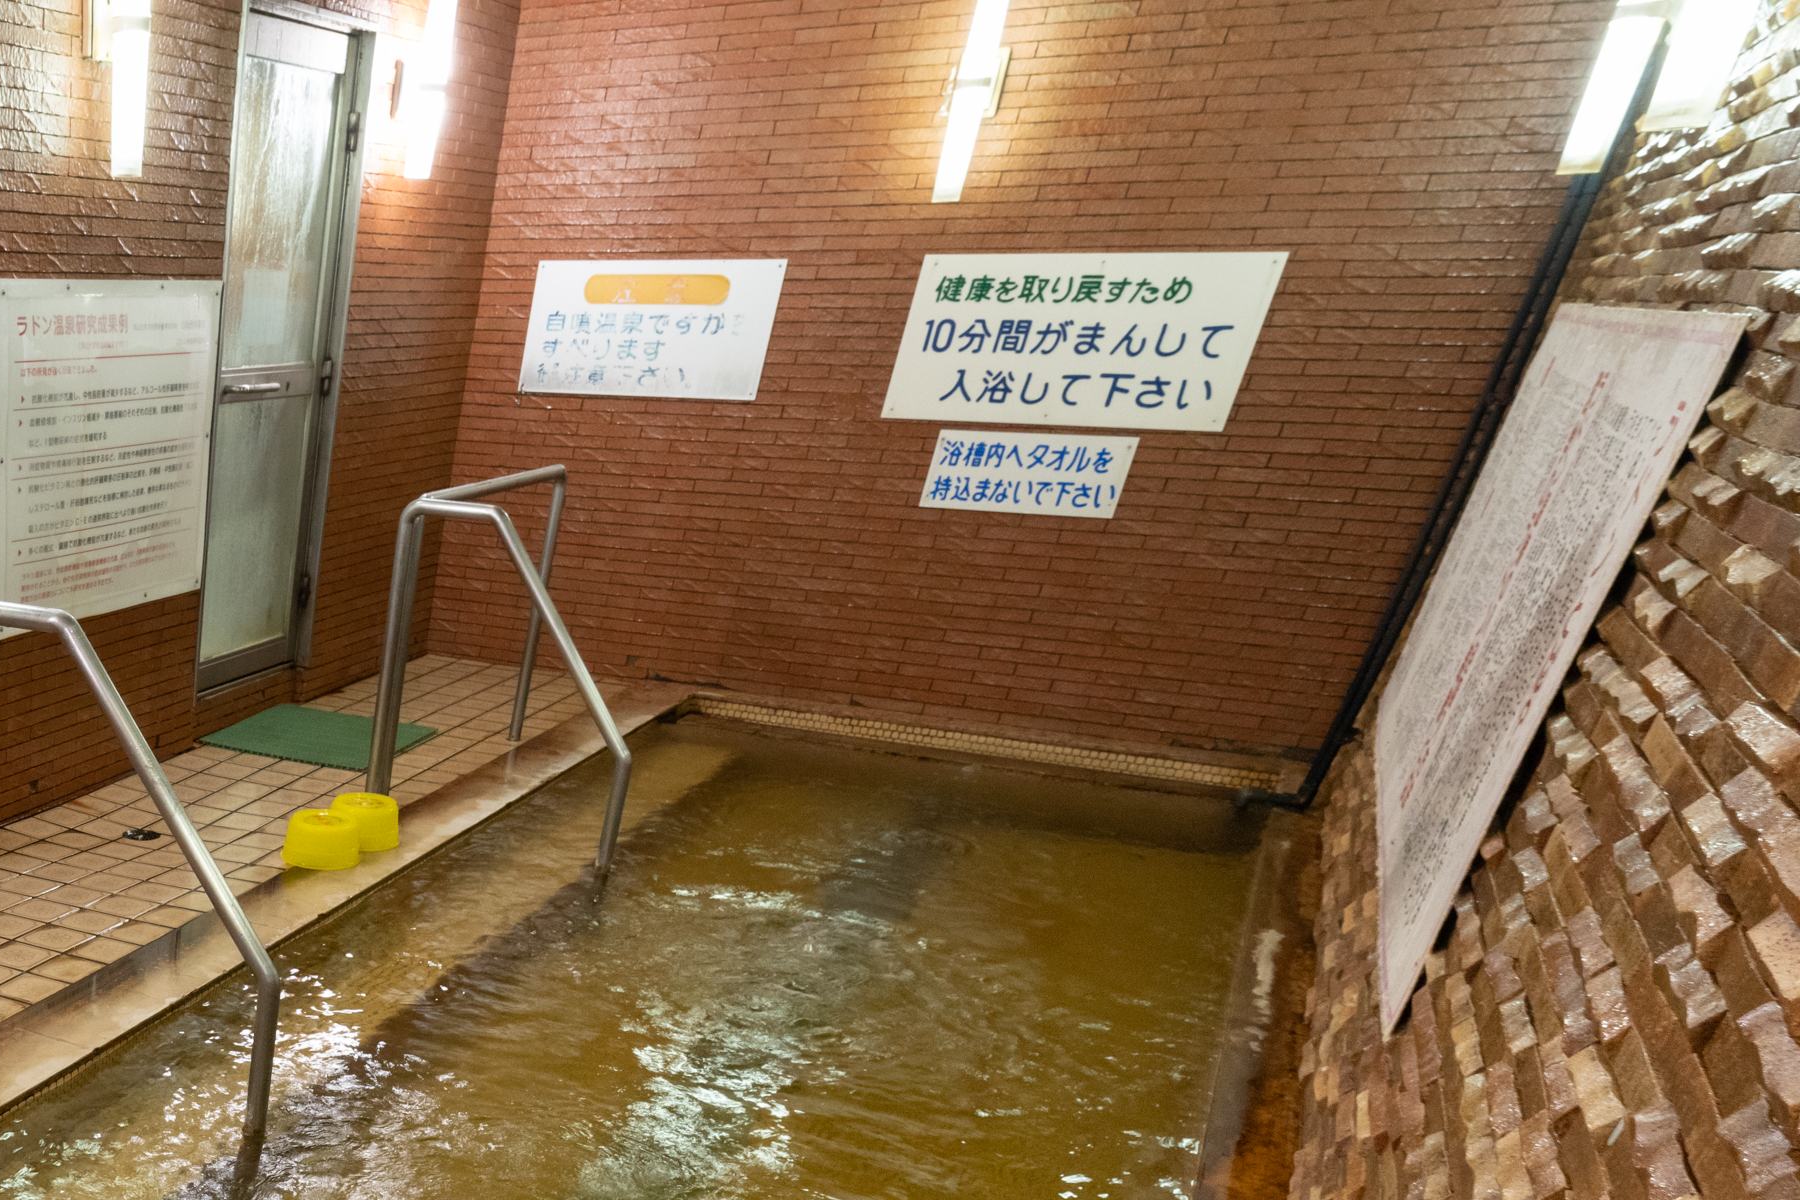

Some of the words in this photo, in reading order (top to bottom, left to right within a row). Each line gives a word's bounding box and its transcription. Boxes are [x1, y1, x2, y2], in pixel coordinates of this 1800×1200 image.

[935, 273, 1193, 304] 健康を取り戻すため
[922, 318, 1235, 358] 10分間がまんして
[939, 368, 1213, 409] 入浴して下さい
[940, 440, 1113, 474] 浴槽内へタオルを
[930, 476, 1117, 509] 持込まないで下さい
